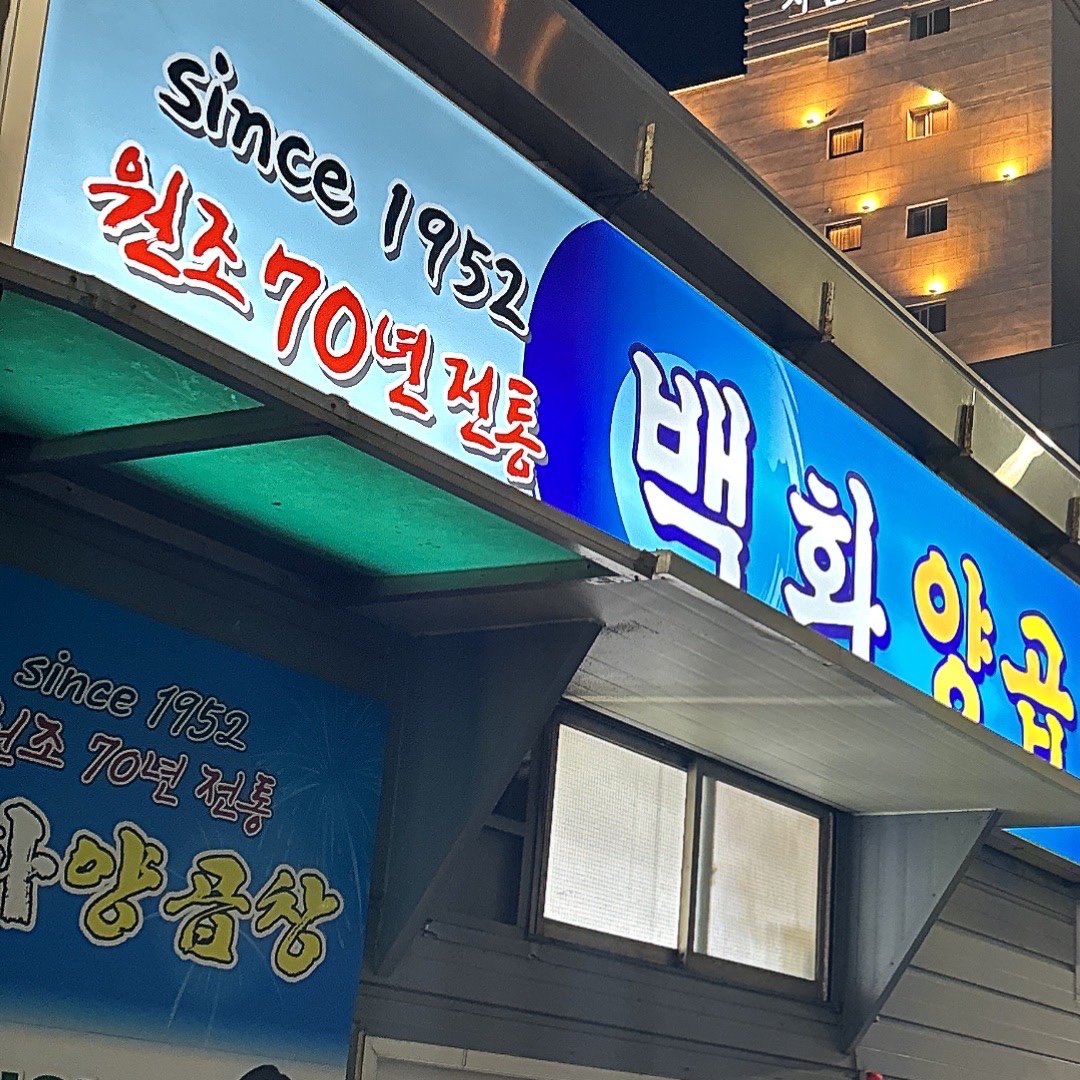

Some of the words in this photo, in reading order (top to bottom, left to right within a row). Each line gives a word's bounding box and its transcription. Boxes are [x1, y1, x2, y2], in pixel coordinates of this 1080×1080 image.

[157, 48, 355, 220] since
[381, 182, 529, 336] 1952
[86, 144, 250, 316] 원조
[262, 241, 434, 422] 70년
[443, 353, 547, 484] 전통
[13, 651, 138, 717] since
[147, 685, 249, 750] 1952
[81, 733, 188, 806] 70년
[194, 764, 277, 836] 전통
